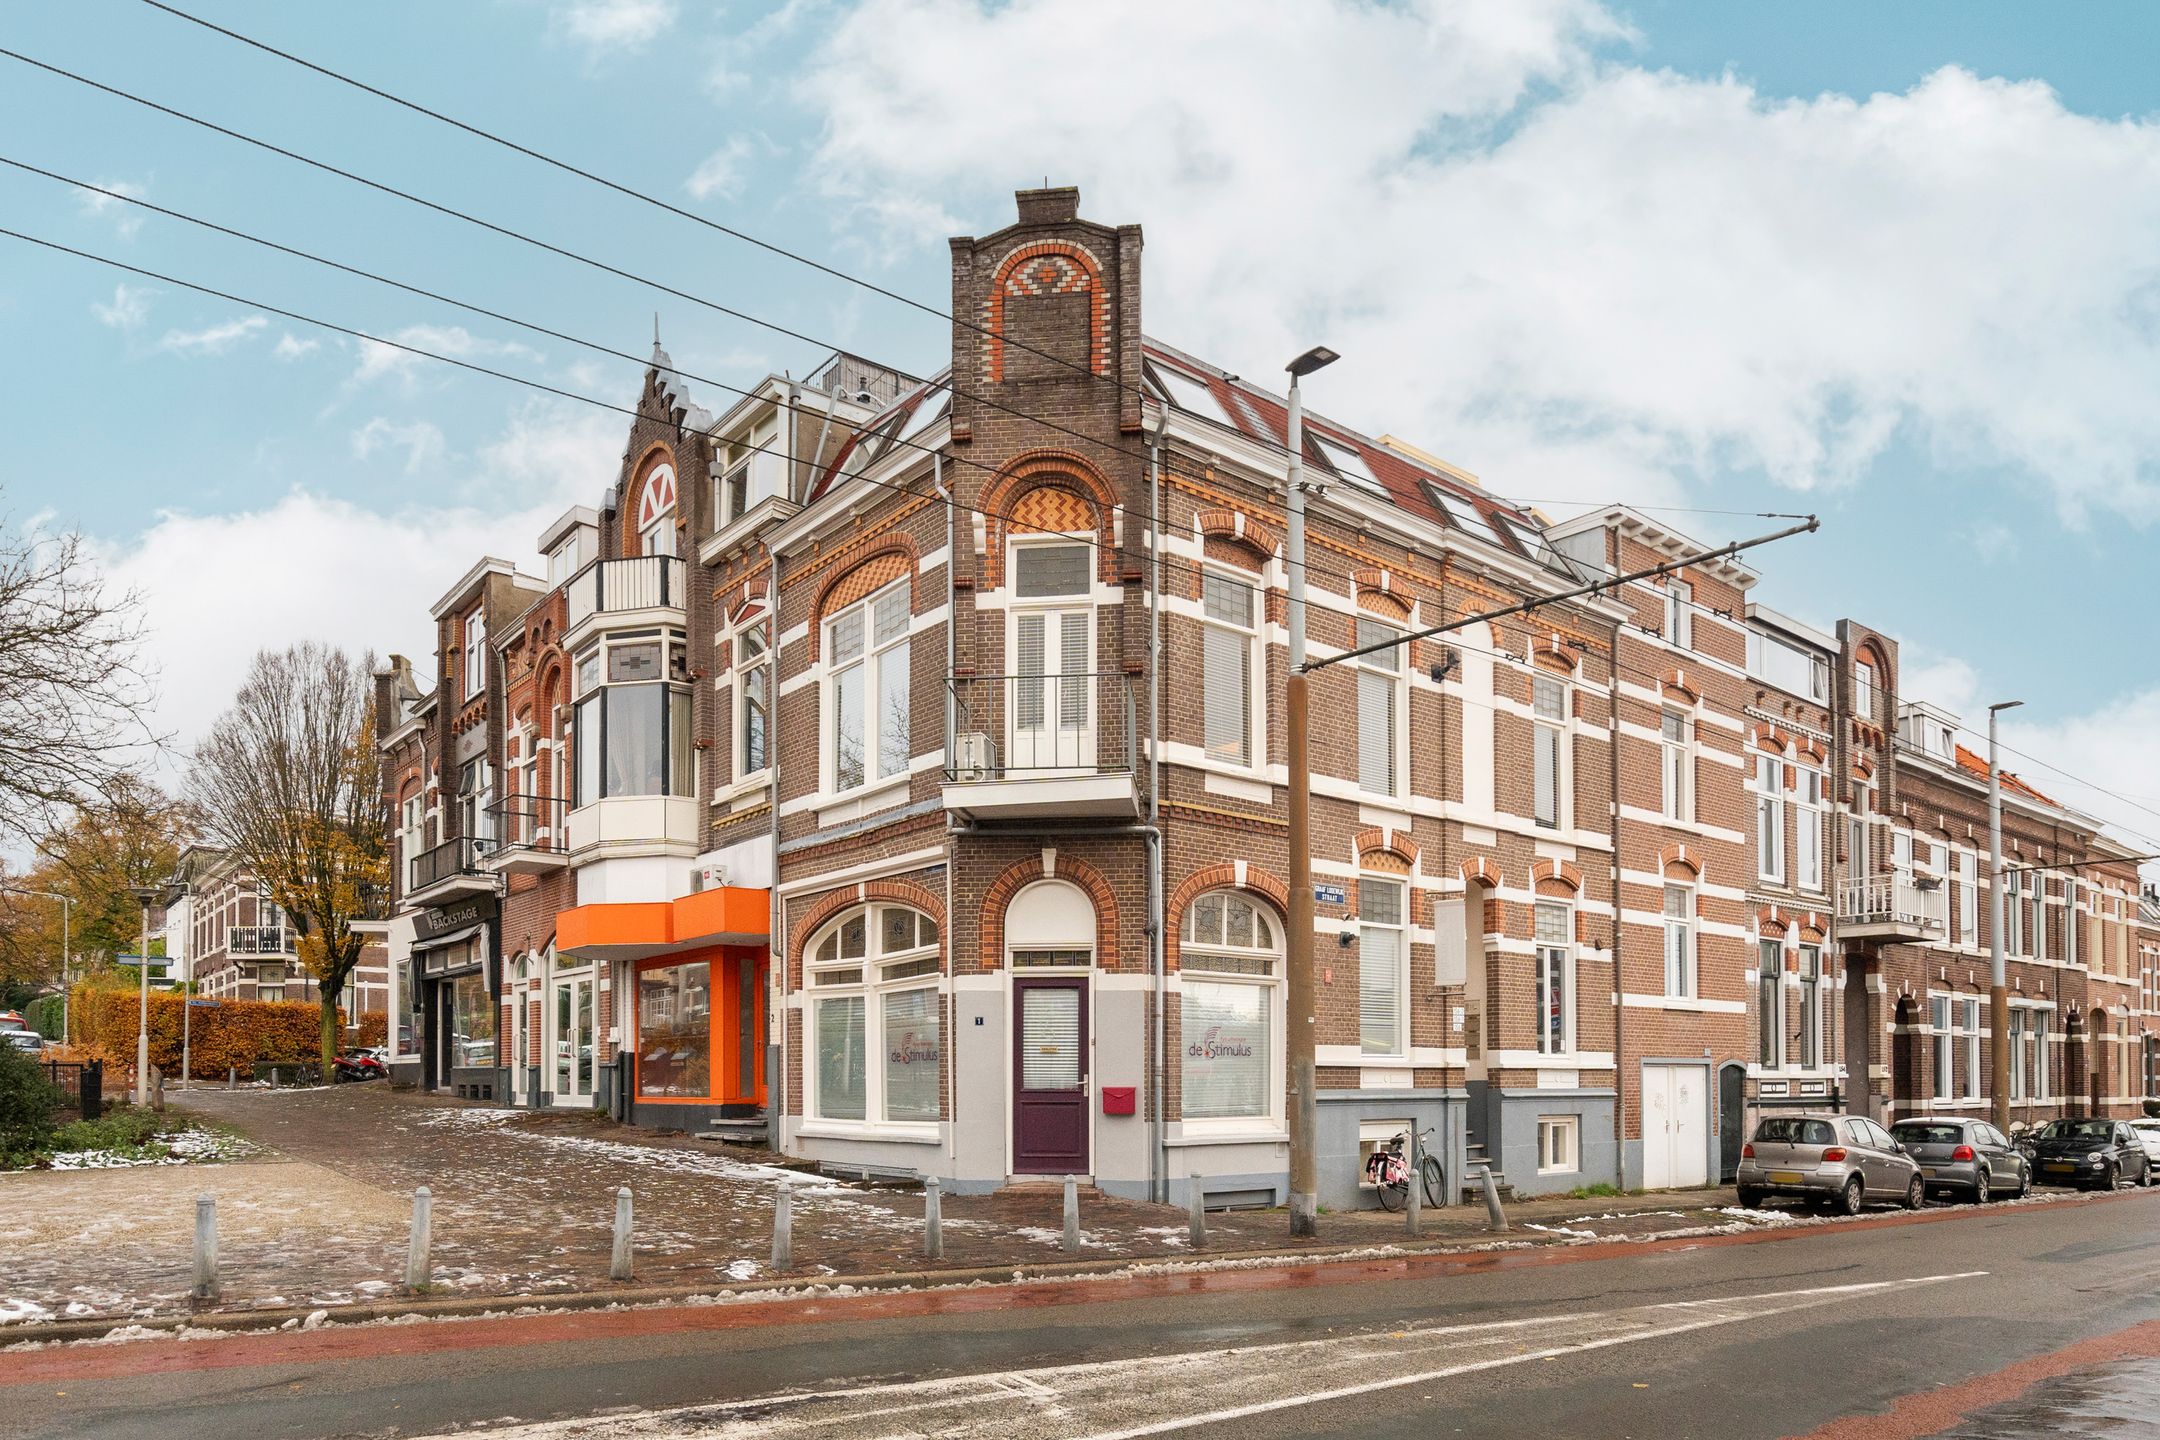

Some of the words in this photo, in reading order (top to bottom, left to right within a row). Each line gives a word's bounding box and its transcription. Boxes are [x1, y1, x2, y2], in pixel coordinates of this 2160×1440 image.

[1321, 893, 1338, 901] STRAAT
[432, 906, 478, 930] BACKSTAGE
[1188, 1041, 1203, 1057] de
[1208, 1040, 1252, 1059] Stimulus
